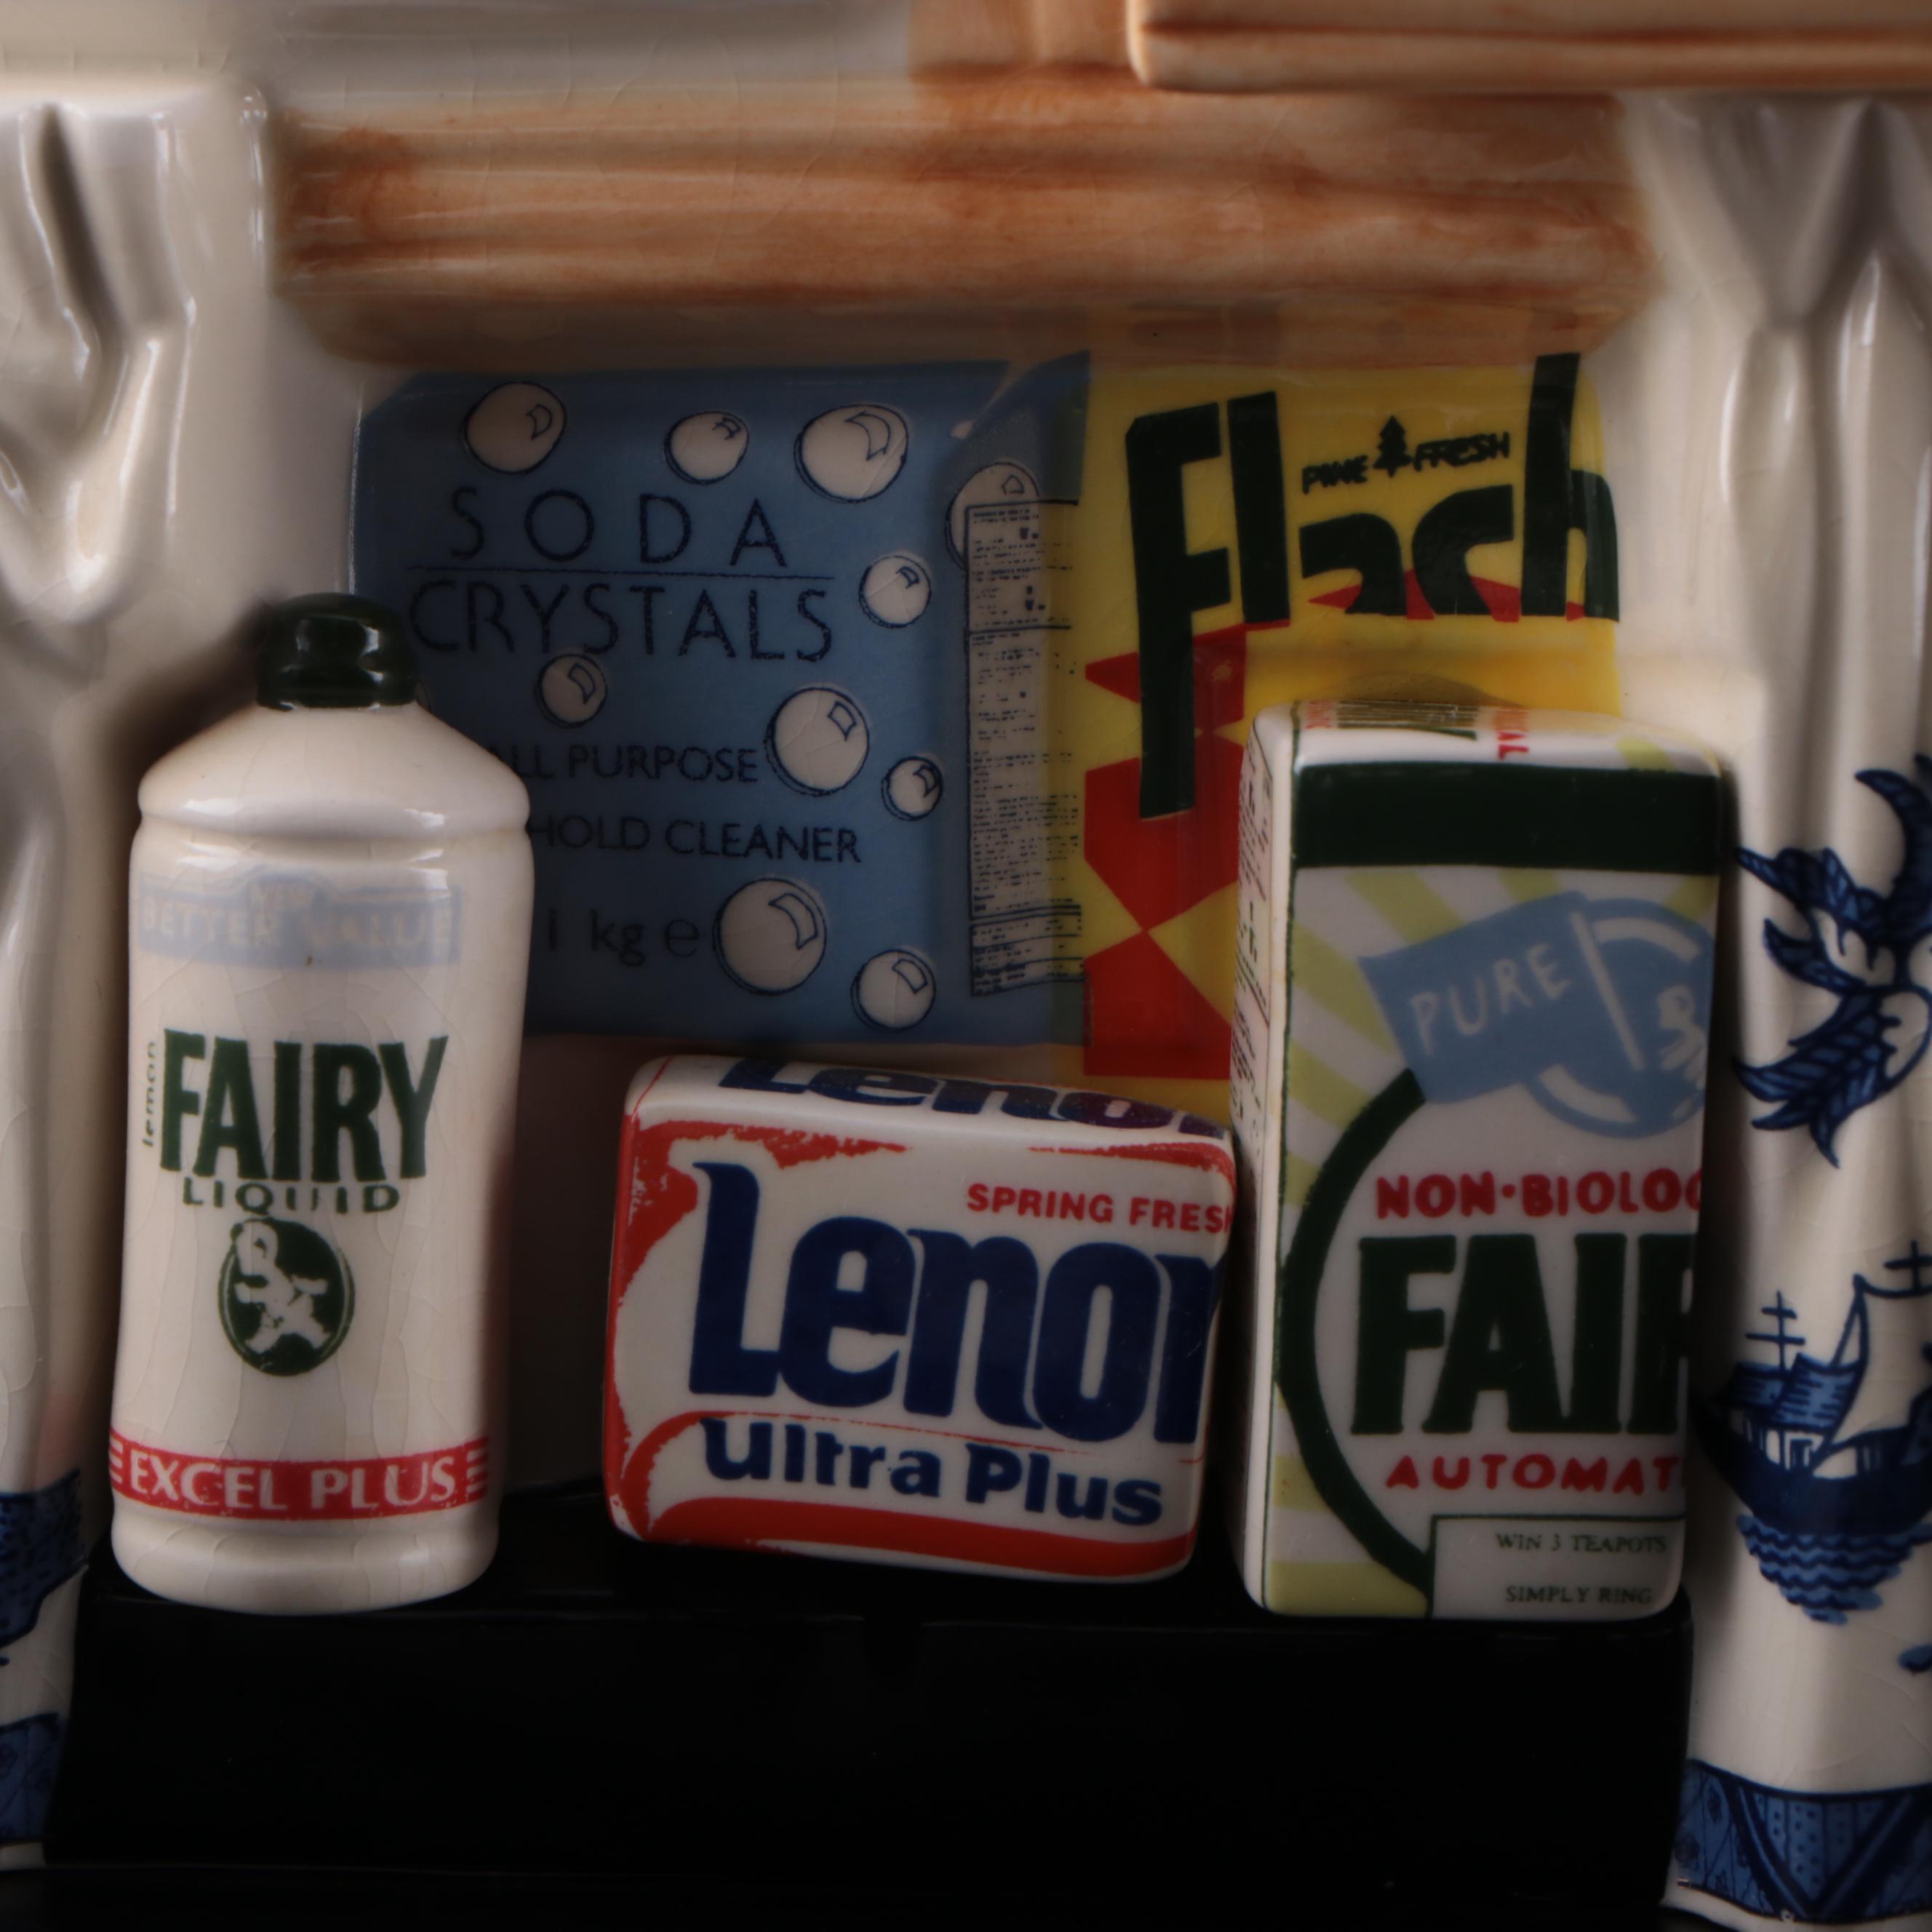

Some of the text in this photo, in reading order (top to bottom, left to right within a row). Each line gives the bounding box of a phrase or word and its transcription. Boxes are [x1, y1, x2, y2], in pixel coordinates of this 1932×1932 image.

[1302, 432, 1510, 495] PINE FRESH
[450, 485, 787, 568] SODA
[409, 579, 833, 662] CRYSTALS
[489, 743, 759, 783] LL PURPOSE
[665, 819, 862, 863] CLEANER
[591, 909, 646, 967] kg
[1408, 943, 1575, 1058] PURE
[159, 1028, 450, 1183] FAIRY
[183, 1177, 400, 1216] LIQUID
[967, 1183, 1114, 1224] SPRING
[129, 1451, 456, 1511] EXCEL PLUS
[699, 1417, 1163, 1527] Ultra Plus
[1496, 1533, 1667, 1553] WIN 3 TEAPOTS
[1506, 1585, 1653, 1605] SIMPLY RING
